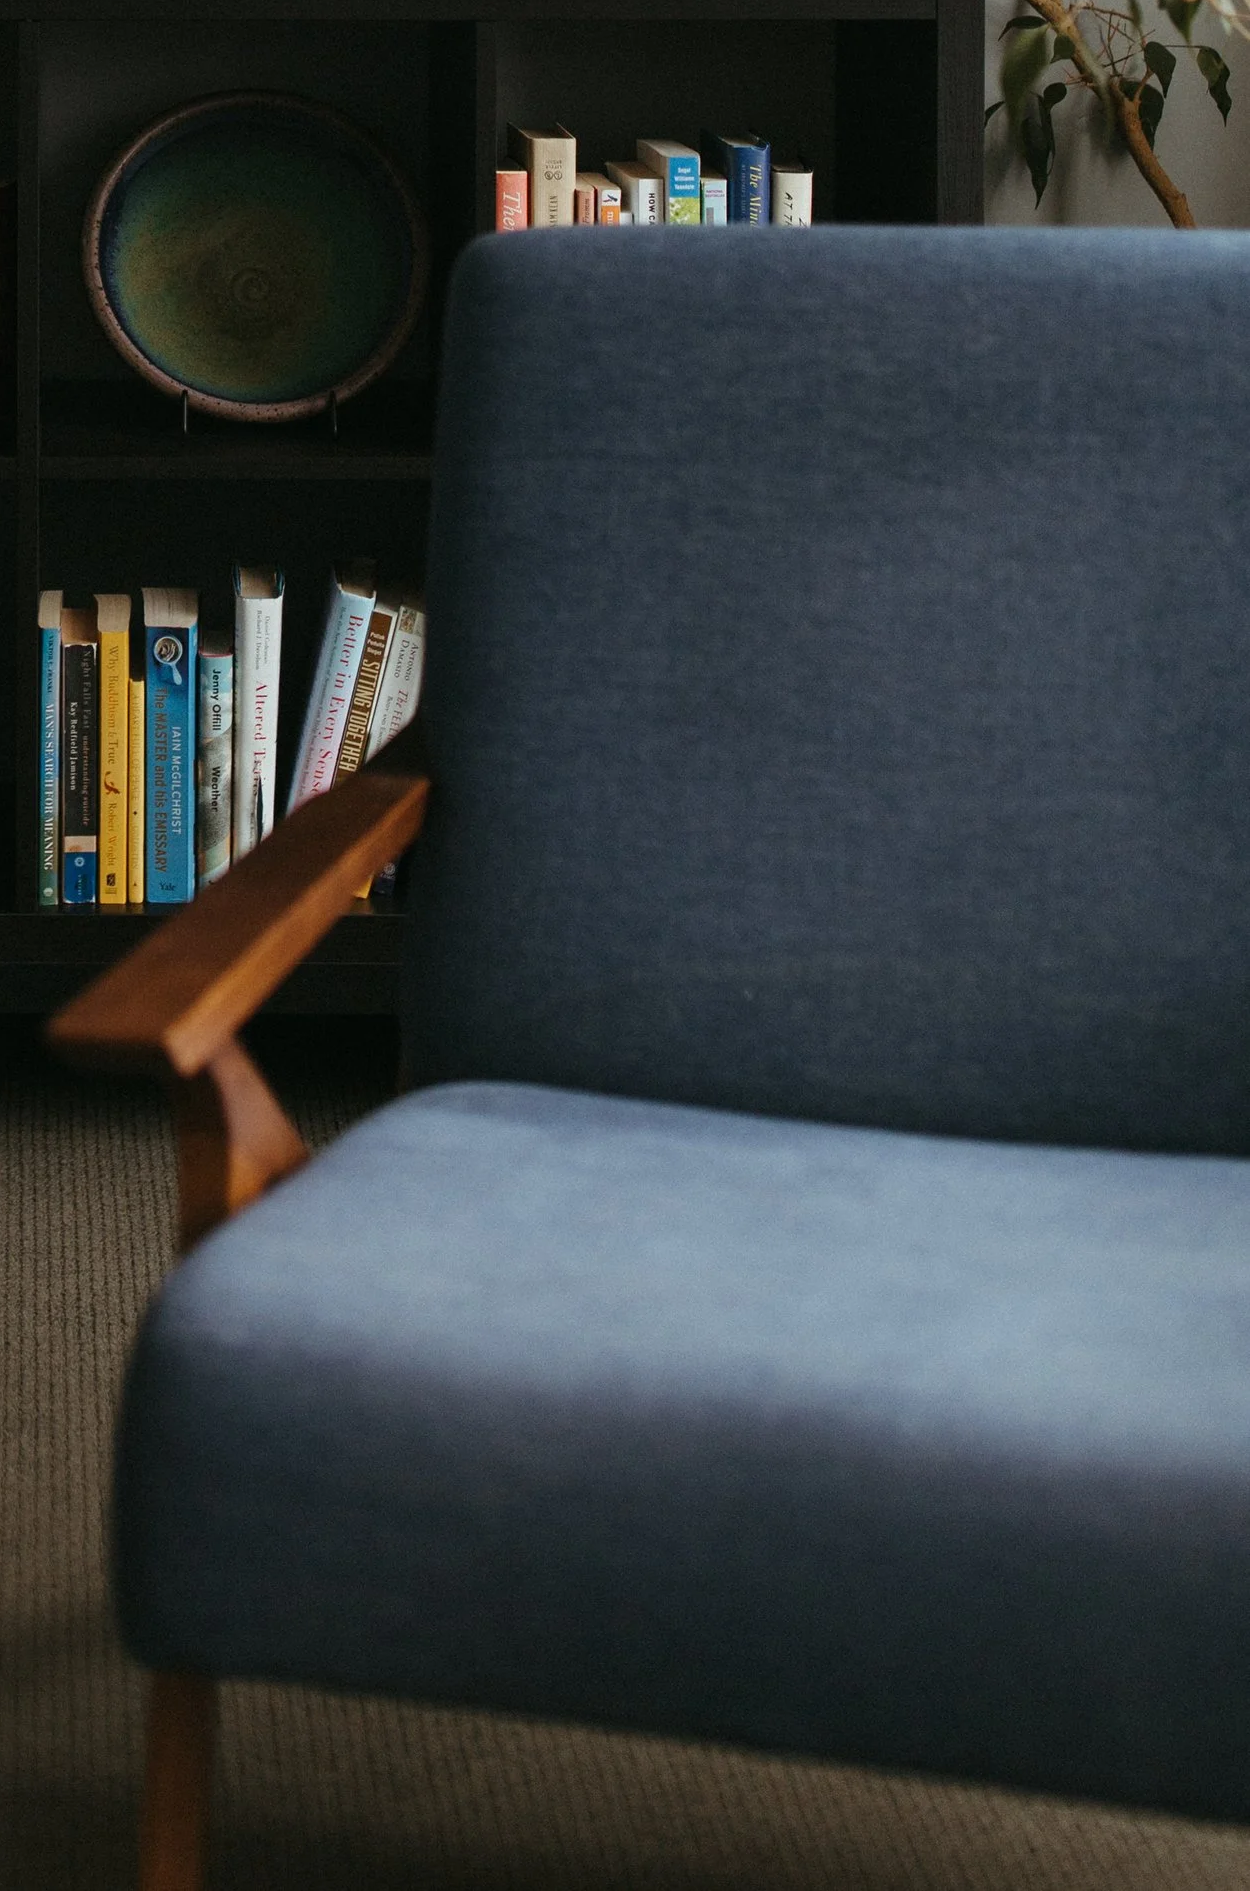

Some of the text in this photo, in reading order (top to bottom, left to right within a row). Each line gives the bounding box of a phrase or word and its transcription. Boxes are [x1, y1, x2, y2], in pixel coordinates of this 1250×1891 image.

[750, 164, 762, 188] The
[784, 192, 793, 210] AT
[339, 615, 364, 667] Better
[394, 639, 410, 679] DAMASIO
[404, 642, 420, 681] ANTONIO
[105, 646, 119, 765] Why Buddhism True
[209, 669, 223, 731] Jenny Offill
[254, 680, 268, 741] Altered
[334, 672, 352, 689] in
[395, 689, 409, 709] The
[81, 650, 92, 825] Night Falls Fast understanding suicide
[319, 696, 346, 742] Every
[339, 659, 379, 772] SITTING TOGETHER
[68, 702, 78, 791] Kay Redfield Jamison
[44, 703, 55, 870] MAN'S SEARCH FOR MEANING
[154, 687, 167, 873] The MASTER and his EMISSARY
[171, 726, 182, 835] IAIN McGILCHRIST
[211, 765, 222, 812] Weather
[106, 802, 118, 866] Robert Wright
